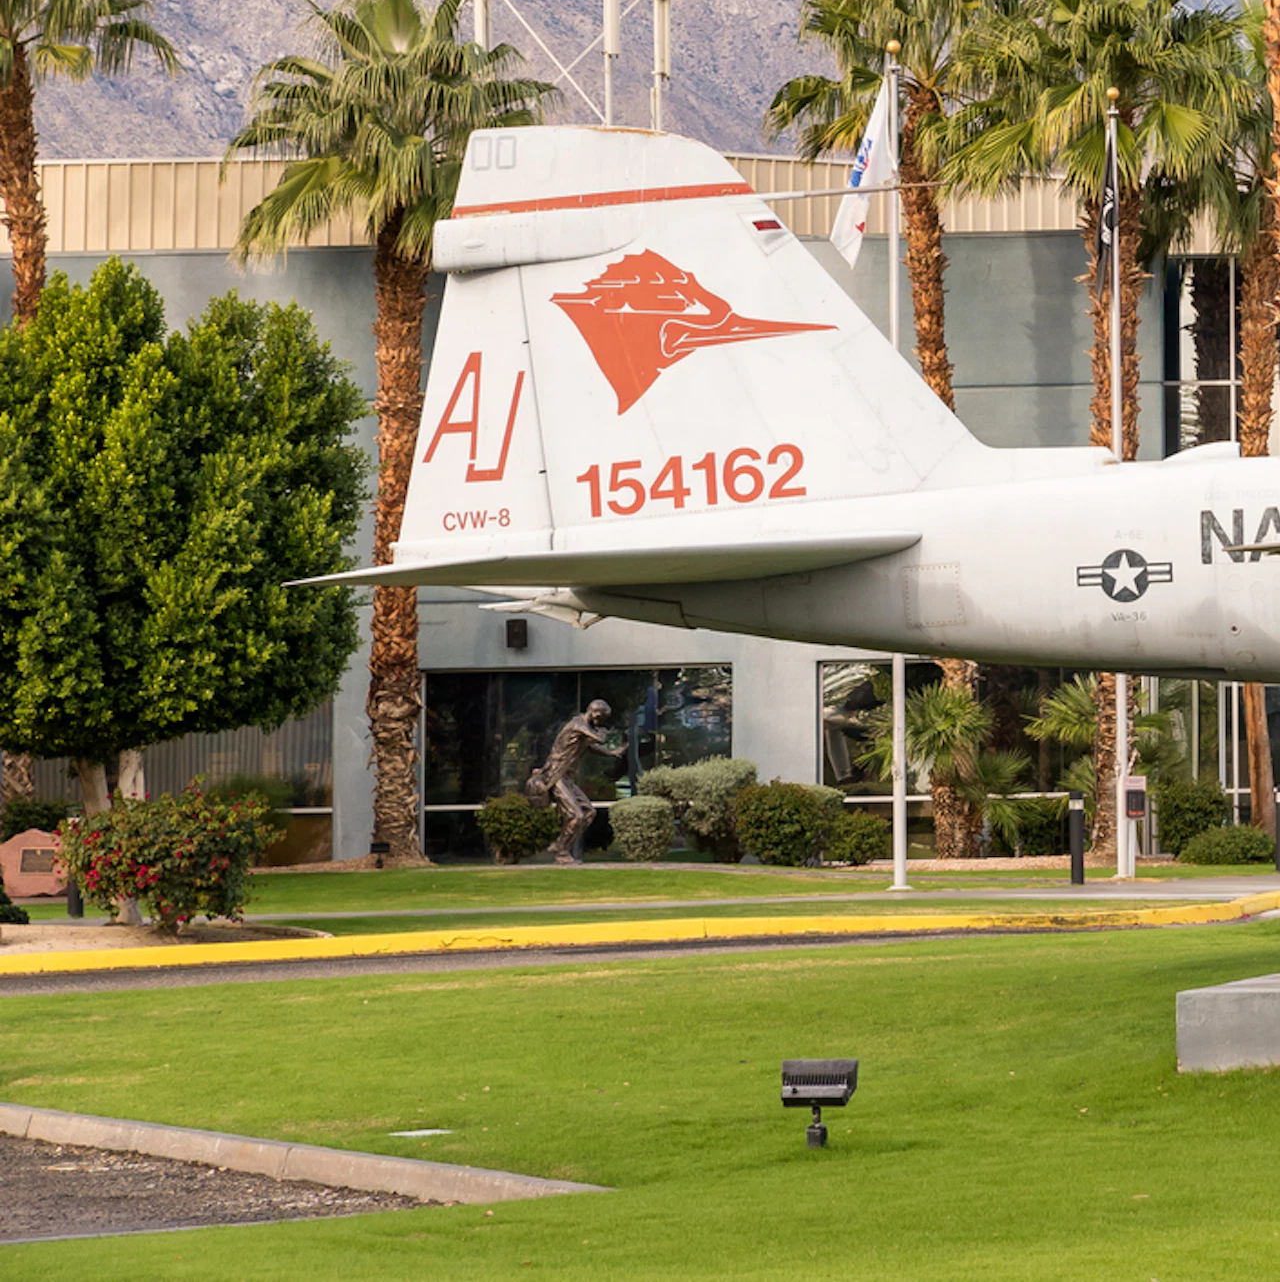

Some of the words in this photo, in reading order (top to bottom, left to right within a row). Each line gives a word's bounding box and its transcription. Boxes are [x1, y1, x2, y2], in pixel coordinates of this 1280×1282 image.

[423, 351, 524, 482] AJ
[576, 443, 807, 518] 154162
[443, 507, 511, 532] CVW-8
[1113, 528, 1145, 540] A-6E
